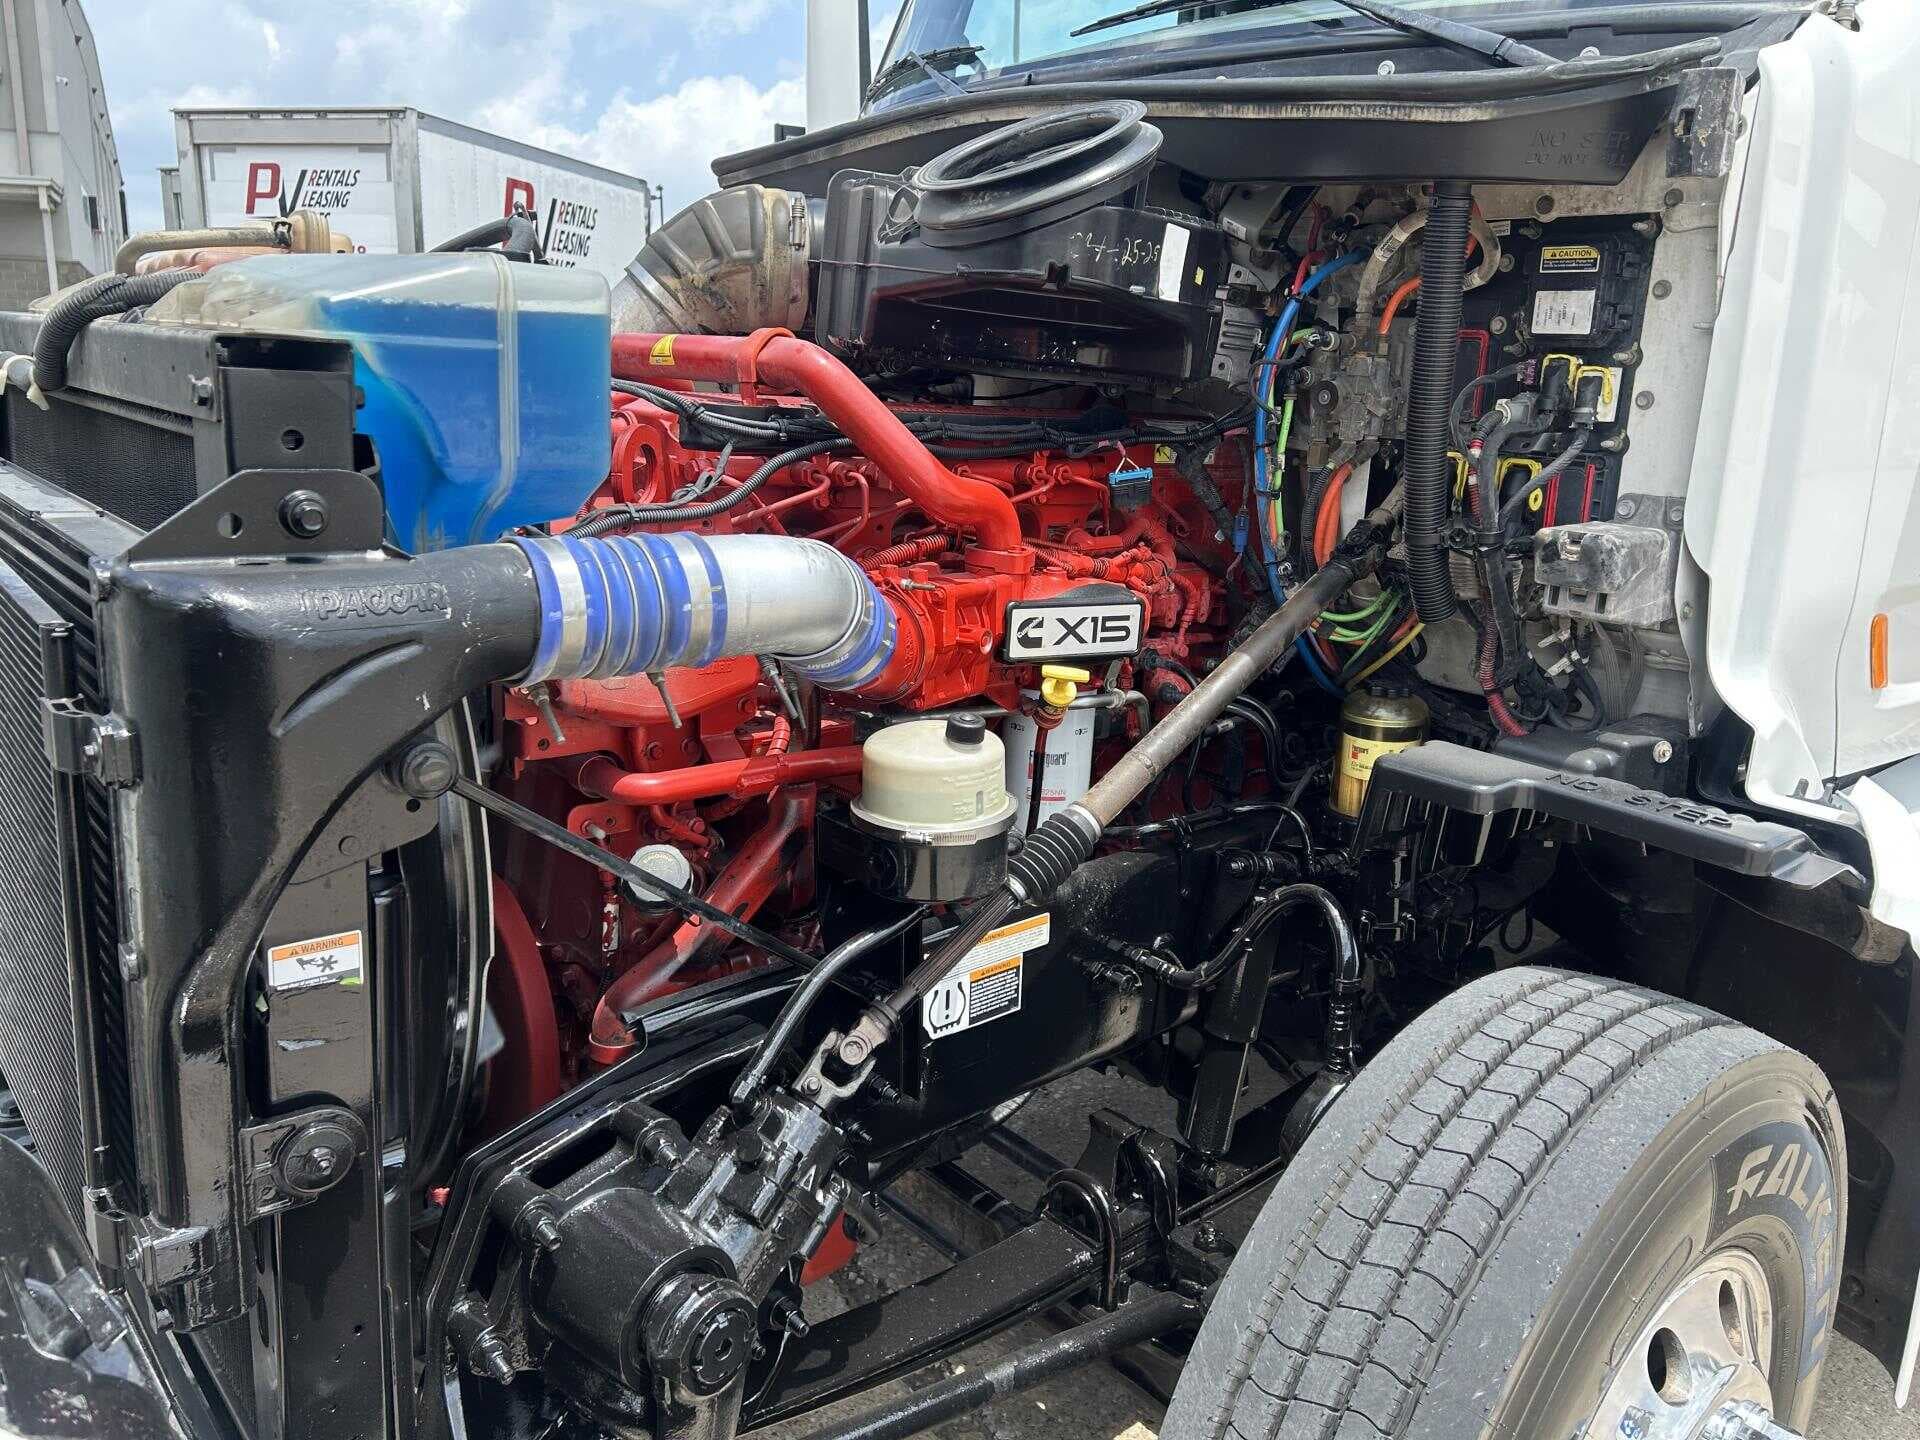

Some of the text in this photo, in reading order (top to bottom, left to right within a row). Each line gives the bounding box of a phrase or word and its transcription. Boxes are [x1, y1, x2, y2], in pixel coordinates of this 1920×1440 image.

[308, 169, 361, 187] RENTALS
[302, 191, 351, 208] LEASING
[557, 200, 598, 230] RENTALS
[551, 229, 591, 257] LEASING
[318, 582, 448, 620] PACCAR
[1053, 615, 1131, 645] X15
[1546, 773, 1732, 828] NO STEP
[301, 937, 343, 953] WARNING
